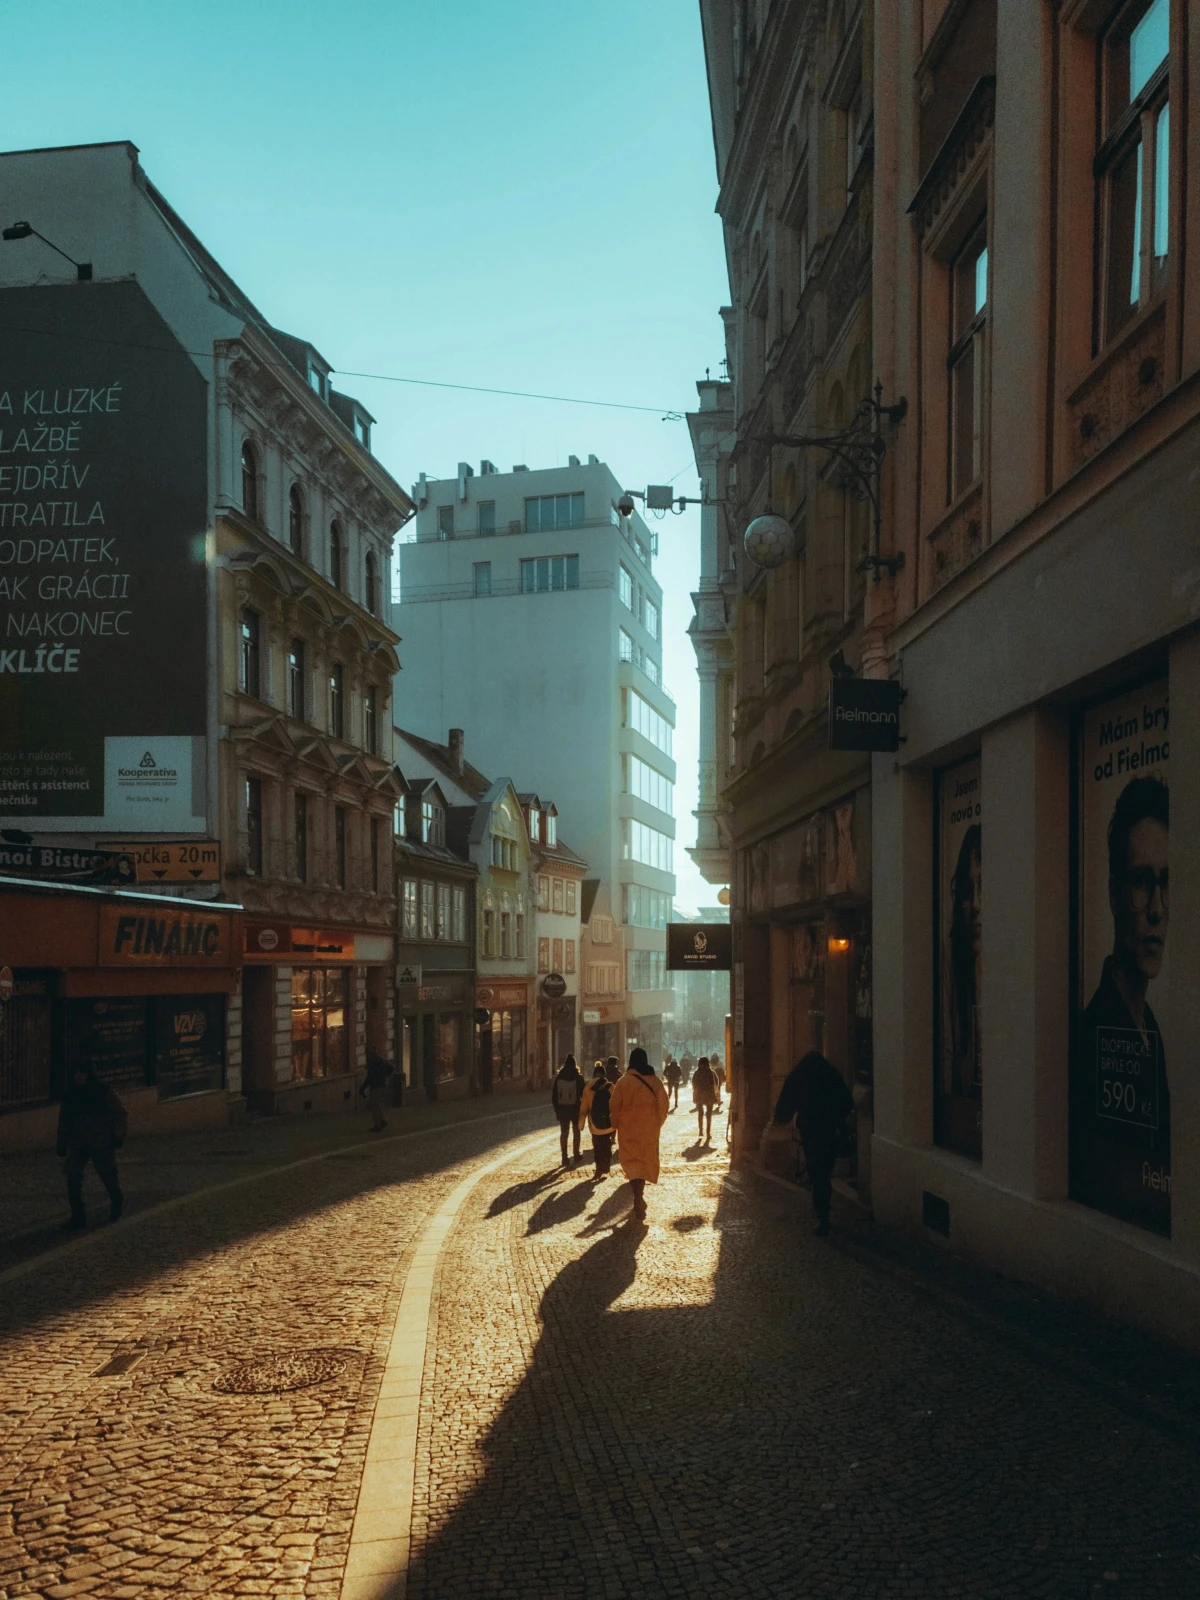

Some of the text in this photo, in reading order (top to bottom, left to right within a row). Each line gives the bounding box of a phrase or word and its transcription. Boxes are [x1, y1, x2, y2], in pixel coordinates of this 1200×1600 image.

[23, 381, 122, 415] KLUZKÉ
[0, 421, 82, 453] LAŽBĚ
[0, 459, 90, 495] EJDŘÍV
[0, 501, 105, 527] TRATILA
[0, 537, 119, 565] ODPATEK,
[38, 569, 130, 600] GRÁCII
[6, 611, 132, 637] NAKONEC
[0, 642, 81, 674] KLÍČE
[1099, 715, 1139, 748] Mám
[19, 750, 25, 760] k
[36, 764, 60, 777] tady
[62, 764, 86, 776] naše
[118, 767, 177, 778] Kooperativa
[1094, 759, 1113, 783] od
[32, 782, 38, 790] s
[41, 779, 90, 790] asistencí
[950, 800, 973, 824] nová
[115, 916, 219, 957] FINANC
[1101, 1037, 1153, 1058] DIOPTRICKÉ
[1101, 1054, 1141, 1076] BRÝLE OD
[1101, 1079, 1136, 1113] 590
